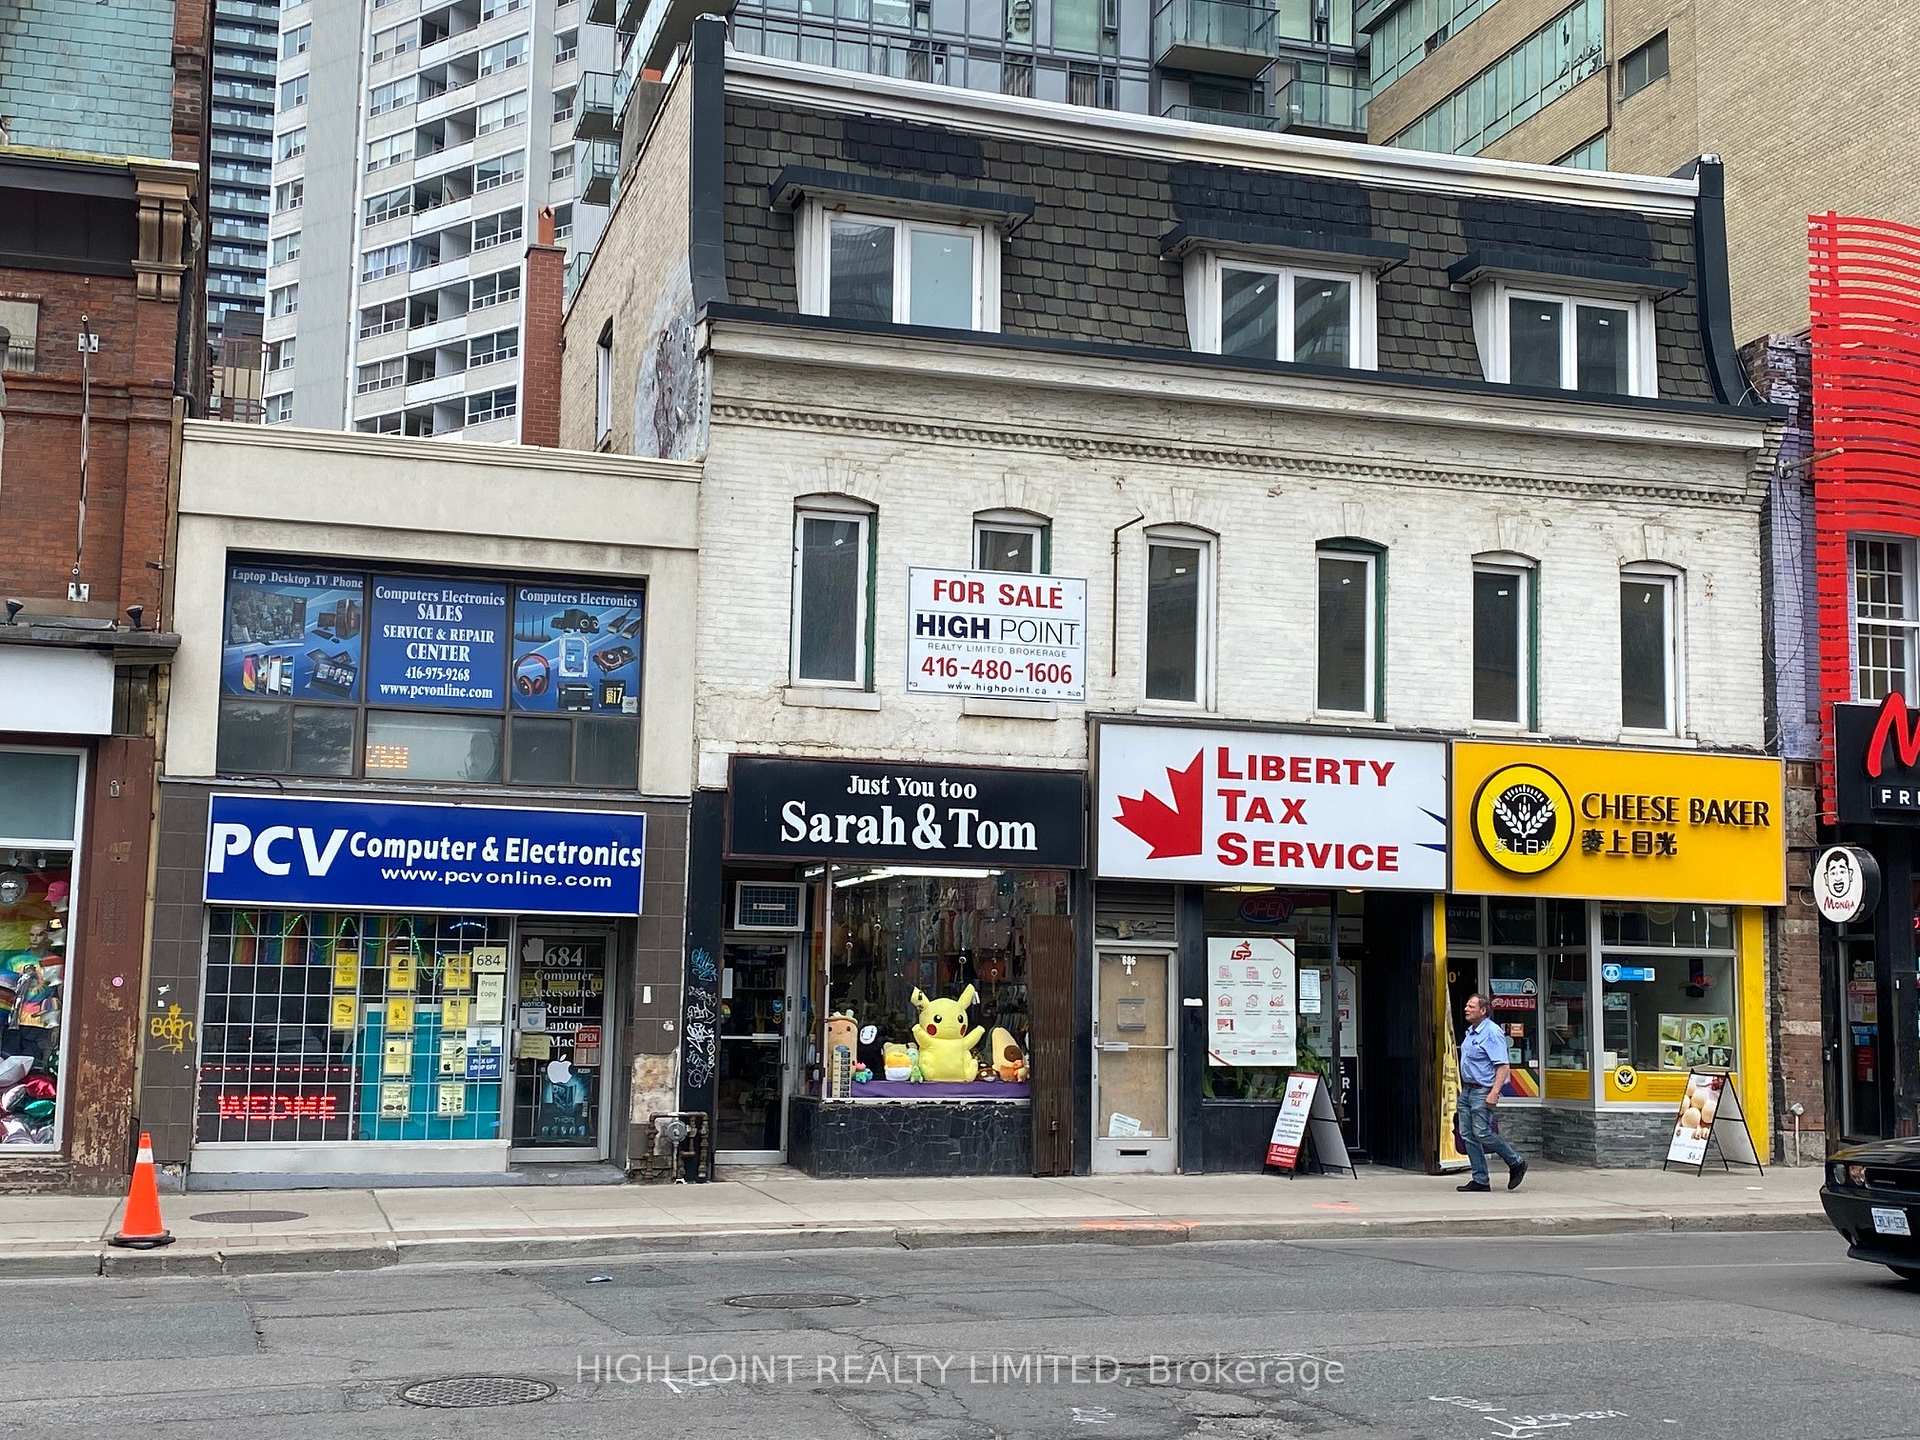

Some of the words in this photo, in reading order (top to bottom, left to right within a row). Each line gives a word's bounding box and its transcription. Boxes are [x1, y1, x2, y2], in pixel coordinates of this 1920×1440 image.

[232, 569, 266, 584] Laptop
[375, 586, 439, 604] Computers
[442, 589, 505, 606] Electronics
[519, 588, 577, 604] Computers
[580, 592, 638, 607] Electronics
[933, 579, 985, 604] FOR
[998, 583, 1063, 609] SALE
[417, 603, 463, 622] SALES
[383, 624, 434, 640] SERVICE
[436, 628, 446, 641] &
[450, 628, 495, 643] REPAIR
[916, 613, 990, 640] HIGH
[1000, 618, 1080, 646] POINT
[406, 642, 470, 662] CENTER
[928, 642, 962, 651] REALTY
[1009, 647, 1067, 658] BROKERAGE
[404, 666, 470, 682] 416-975-9268
[921, 656, 1073, 684] 416-480-1606
[380, 683, 493, 699] www.pcvonline.com
[947, 682, 1047, 695] www.highpoint.ca
[1217, 746, 1396, 787] LIBERTY
[847, 774, 890, 796] Just
[896, 776, 935, 798] You
[940, 778, 978, 799] too
[1217, 788, 1308, 825] TAX
[1581, 792, 1680, 824] CHEESE
[1689, 797, 1770, 828] BAKER
[781, 800, 907, 846] Sarah
[912, 803, 947, 849] &
[947, 808, 1038, 851] Tom
[208, 822, 349, 877] PCV
[349, 831, 477, 864] Computer
[482, 836, 500, 862] &
[505, 837, 642, 868] Electronics
[1217, 832, 1399, 872] SERVICE
[381, 866, 612, 888] www.pcvonline.com
[1244, 901, 1289, 919] OPEN
[476, 954, 501, 966] 684
[544, 946, 583, 966] 684
[1121, 955, 1137, 966] 686
[534, 969, 594, 984] Computer
[546, 1021, 583, 1033] aptop
[578, 1033, 597, 1041] OPEN
